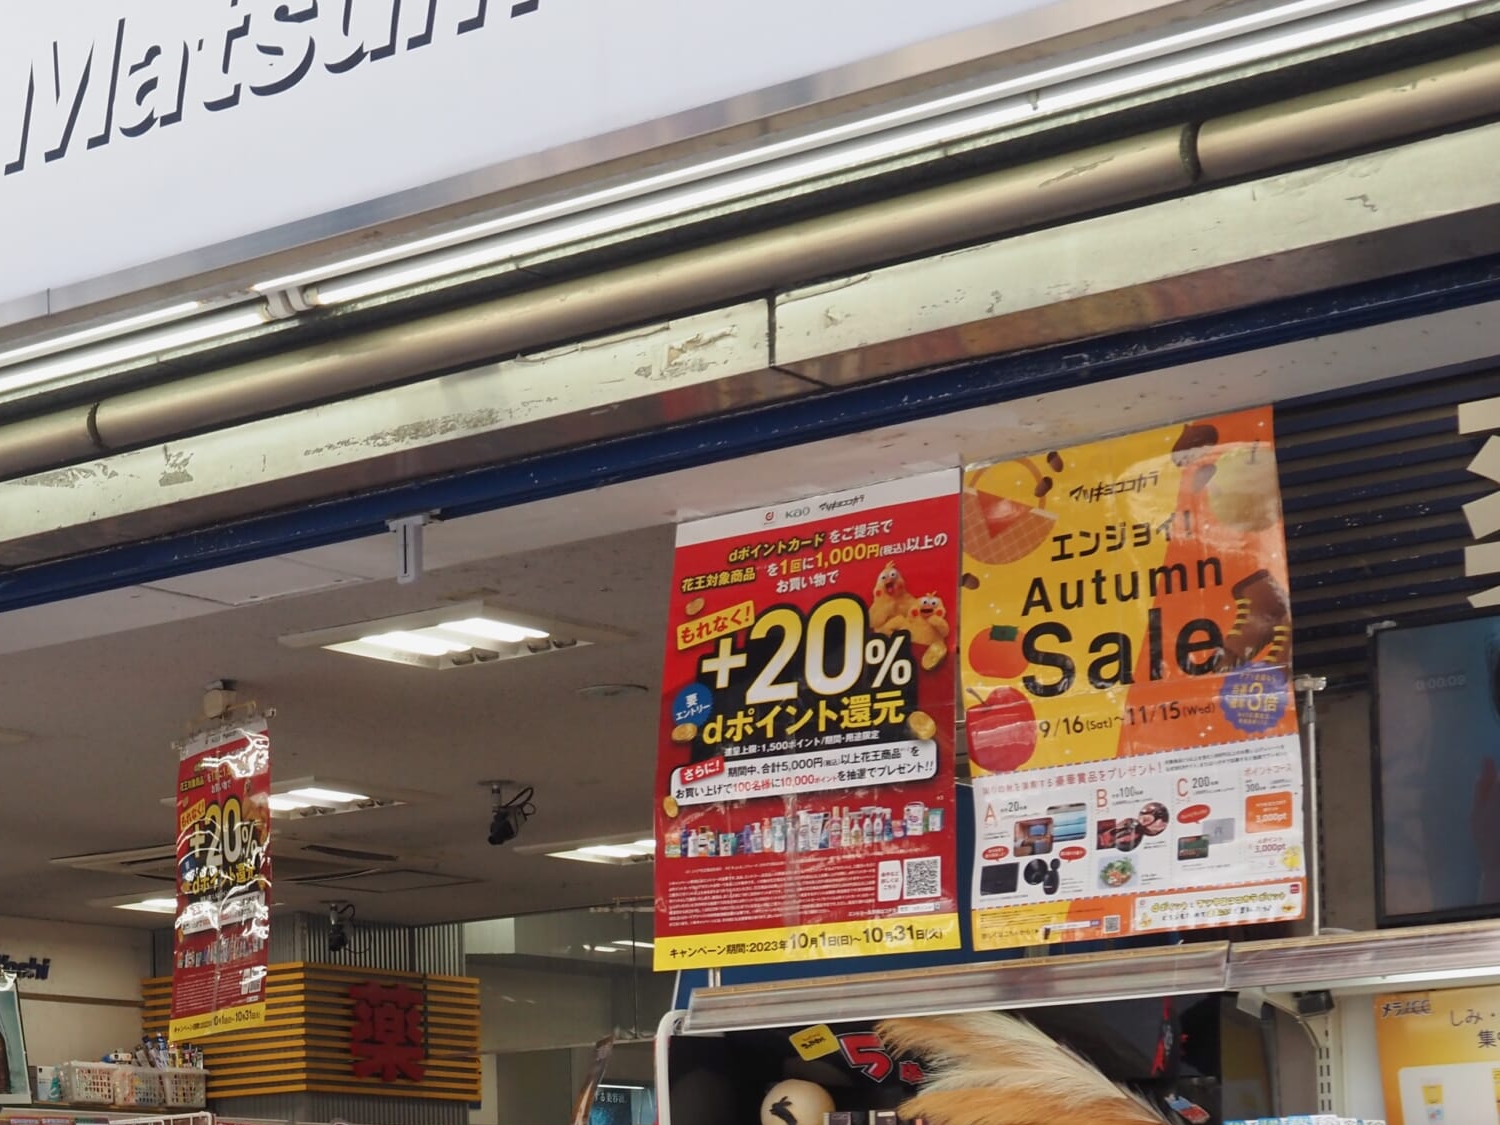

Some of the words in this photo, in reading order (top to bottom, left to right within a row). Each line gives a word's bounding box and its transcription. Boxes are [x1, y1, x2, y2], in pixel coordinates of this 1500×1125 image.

[1069, 471, 1159, 503] マツキヨココカラ
[728, 532, 825, 564] dポイントカード
[829, 519, 894, 543] をご提示で
[680, 569, 757, 593] 花王対象商品
[776, 570, 839, 594] お買い物で
[1021, 556, 1223, 617] Autumn
[680, 605, 752, 645] もれなく!
[701, 596, 913, 706] +20%
[1021, 607, 1224, 697] Sale
[675, 702, 712, 721] エントリー
[702, 695, 907, 745] dポイント還元
[682, 760, 721, 782] さらに!
[1096, 789, 1108, 808] B
[1177, 778, 1189, 796] C
[984, 803, 996, 823] A
